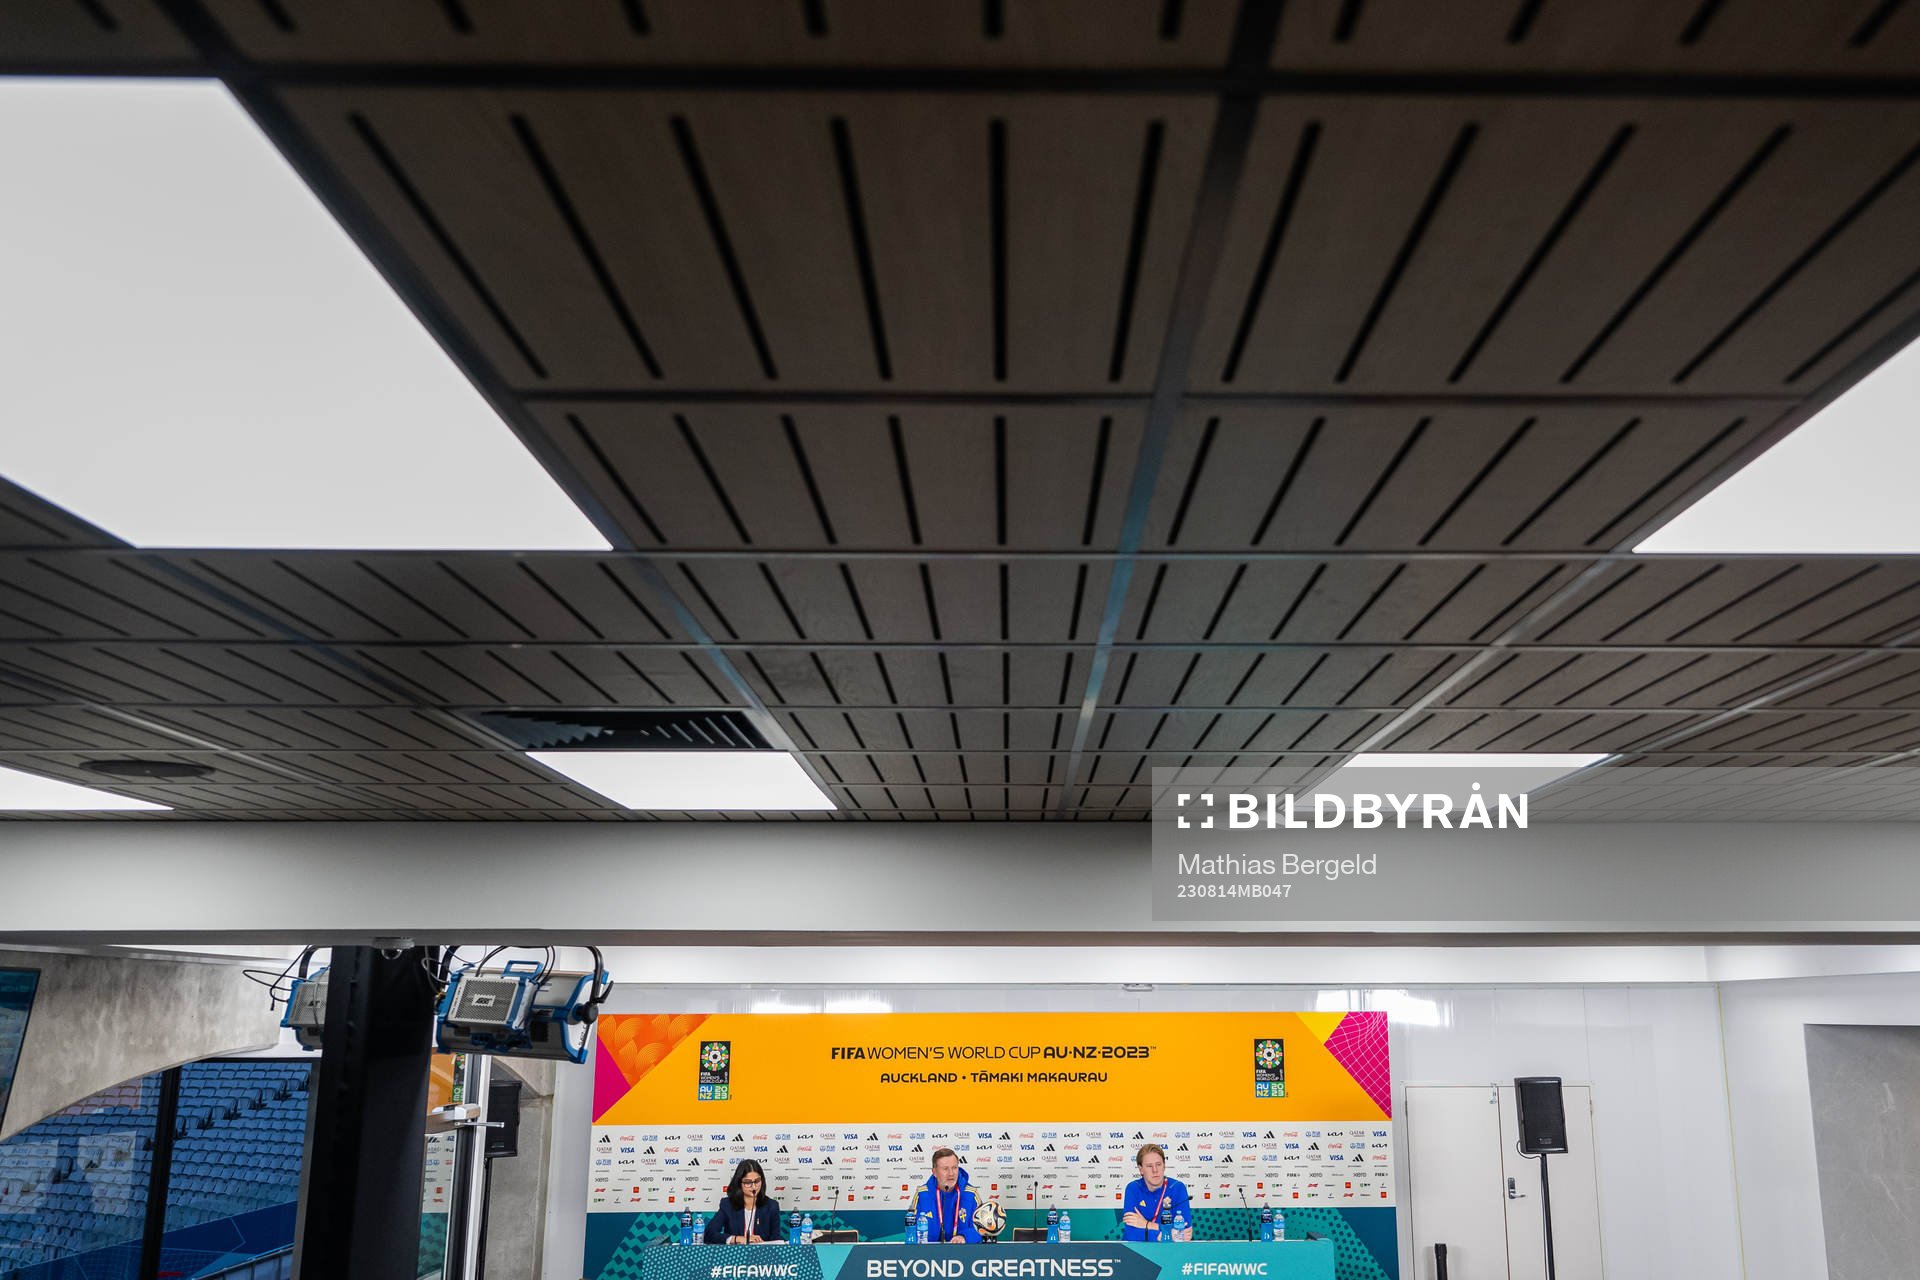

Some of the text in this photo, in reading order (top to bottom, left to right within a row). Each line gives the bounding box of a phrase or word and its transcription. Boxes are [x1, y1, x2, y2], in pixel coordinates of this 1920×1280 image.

[832, 1047, 866, 1059] FIFA
[867, 1047, 944, 1059] WOMEN'S
[948, 1046, 1006, 1059] WORLD
[1008, 1046, 1040, 1058] CUP
[880, 1071, 1108, 1083] AUCKLAND TĀMAKI MAKAURAU
[710, 1264, 798, 1278] #FIFAWWC
[867, 1259, 963, 1277] BEYOND
[1182, 1262, 1268, 1276] #FIFAWWC
